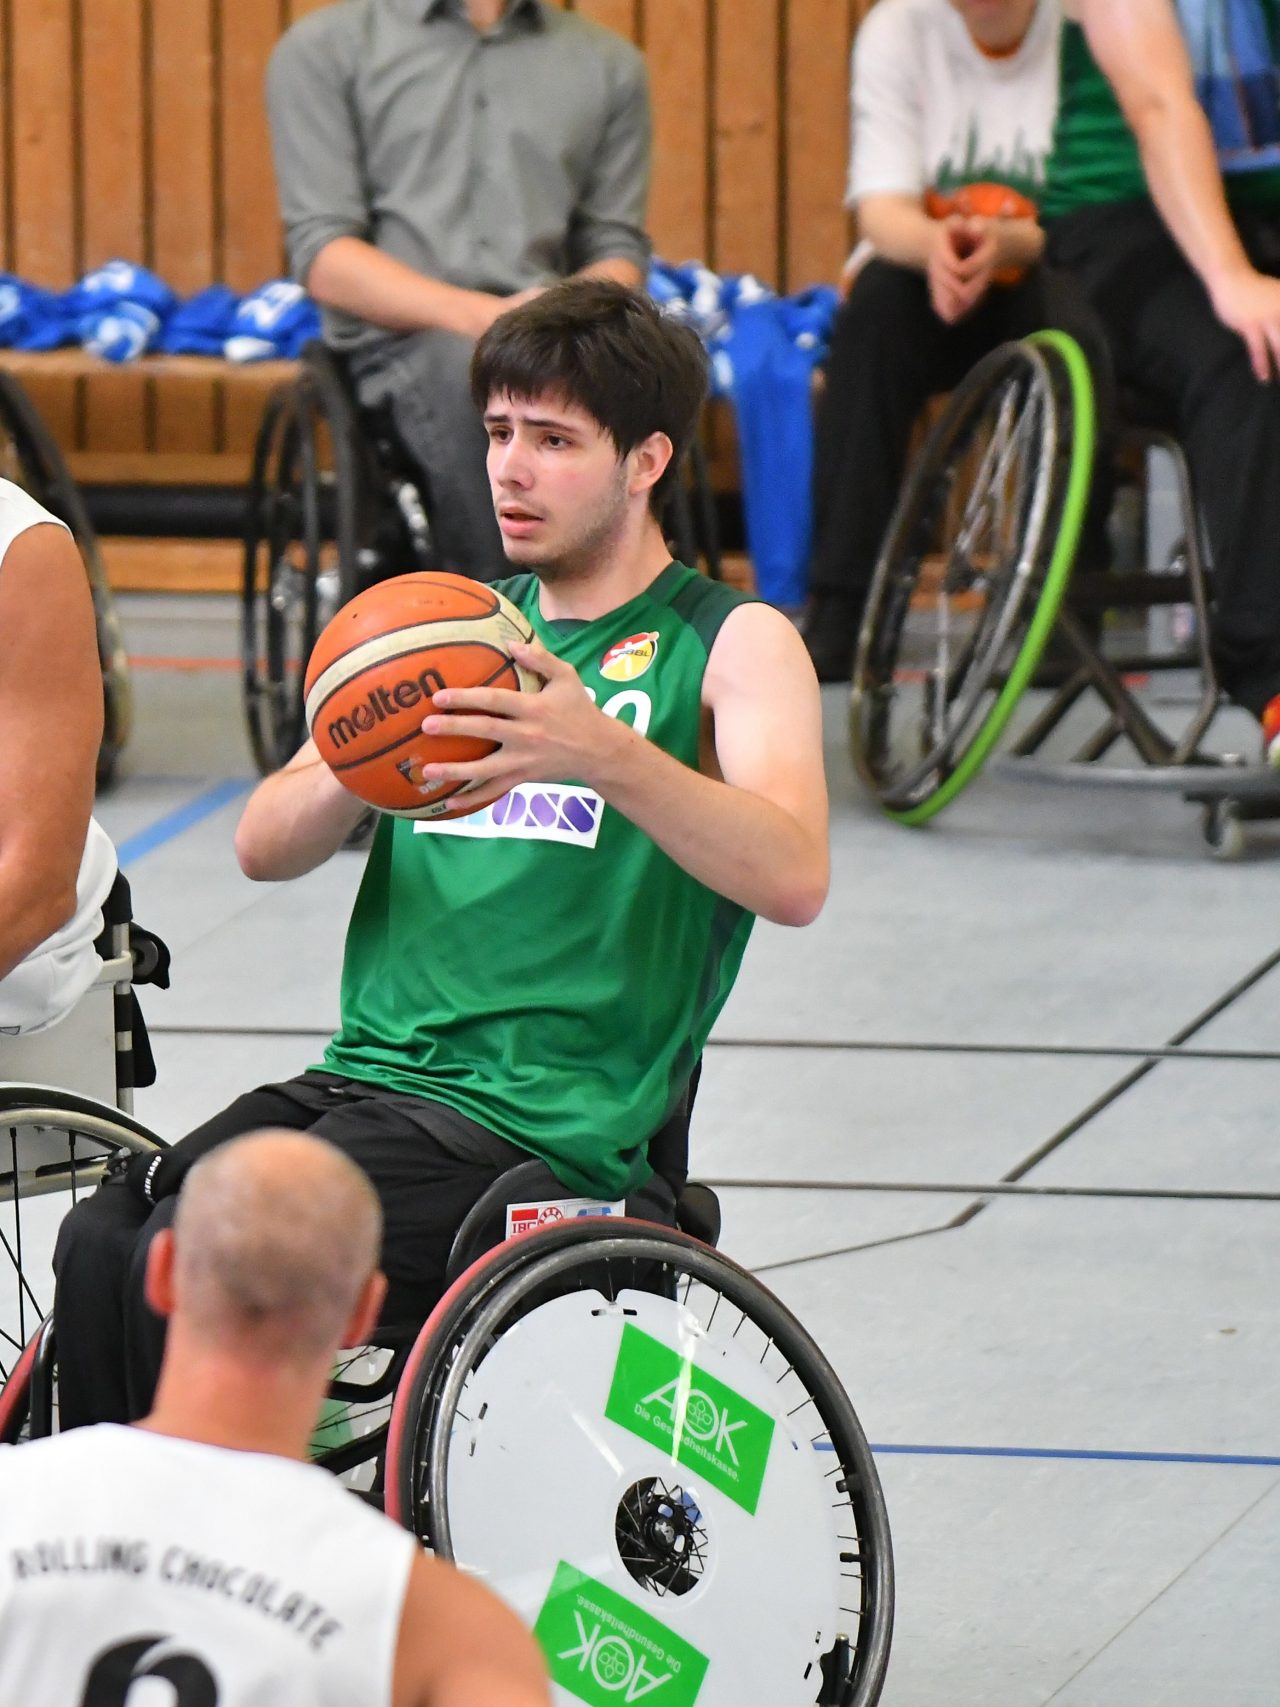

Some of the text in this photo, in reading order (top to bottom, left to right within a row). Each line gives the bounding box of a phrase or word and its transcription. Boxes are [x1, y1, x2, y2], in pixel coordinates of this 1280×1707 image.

[328, 668, 447, 750] molten
[634, 1403, 740, 1482] Die Gesdheitskasse.
[641, 1376, 748, 1466] AOK
[12, 1538, 343, 1653] ROLLING CHOCOLATE
[576, 1593, 681, 1673] Die Gesundheitskasse.
[557, 1610, 673, 1703] AOK
